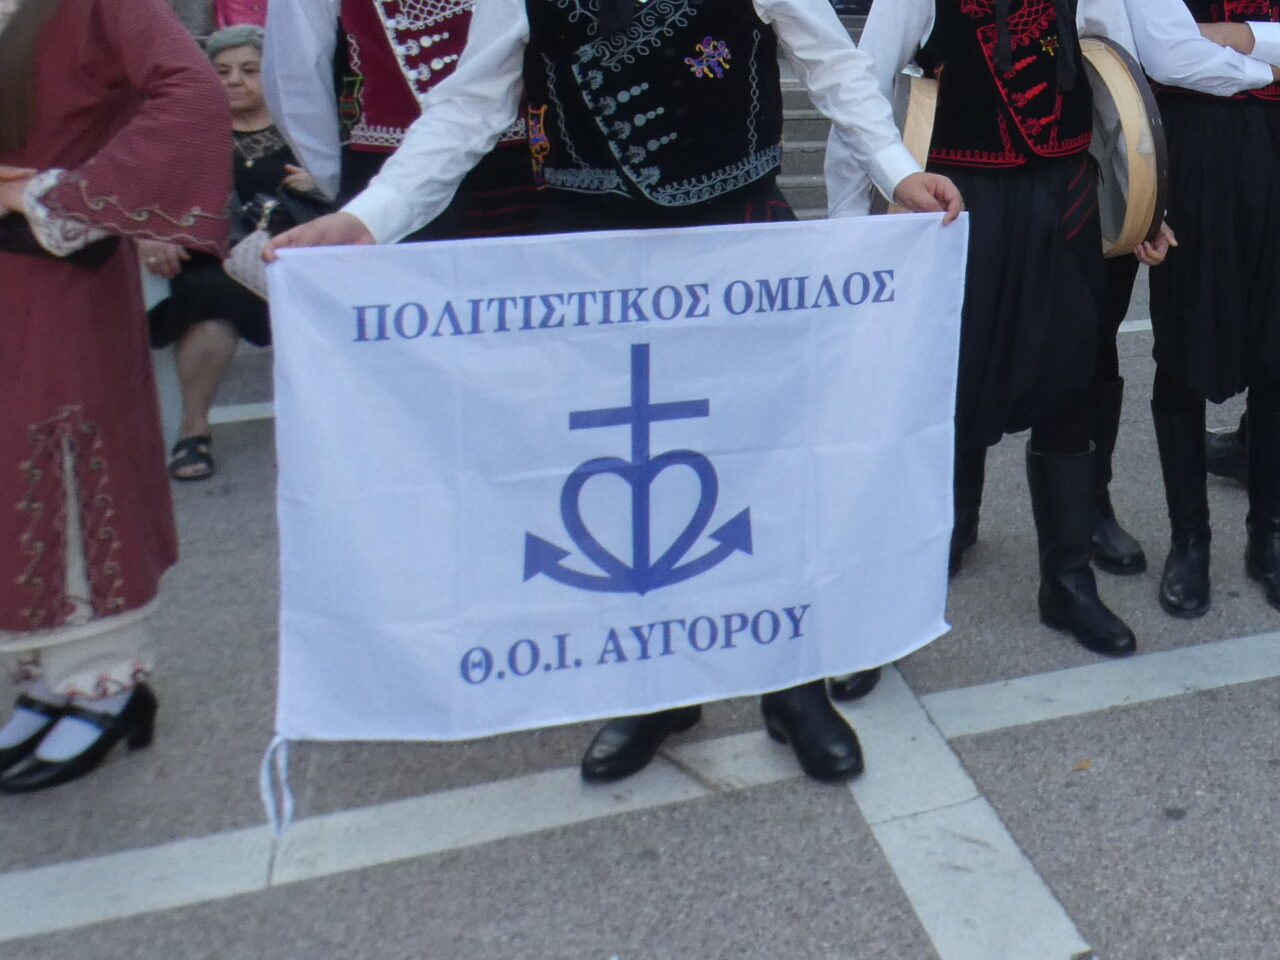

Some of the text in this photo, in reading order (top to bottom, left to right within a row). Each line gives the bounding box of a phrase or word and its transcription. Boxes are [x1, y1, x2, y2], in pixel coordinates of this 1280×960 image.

[352, 269, 896, 342] ΠΟΛΙΤΙΣΤΙΚΟΣ ΟΜΙΛΟΣ
[460, 604, 812, 686] Θ.Ο.Ι. ΑΥΓΟΡΟΥ
